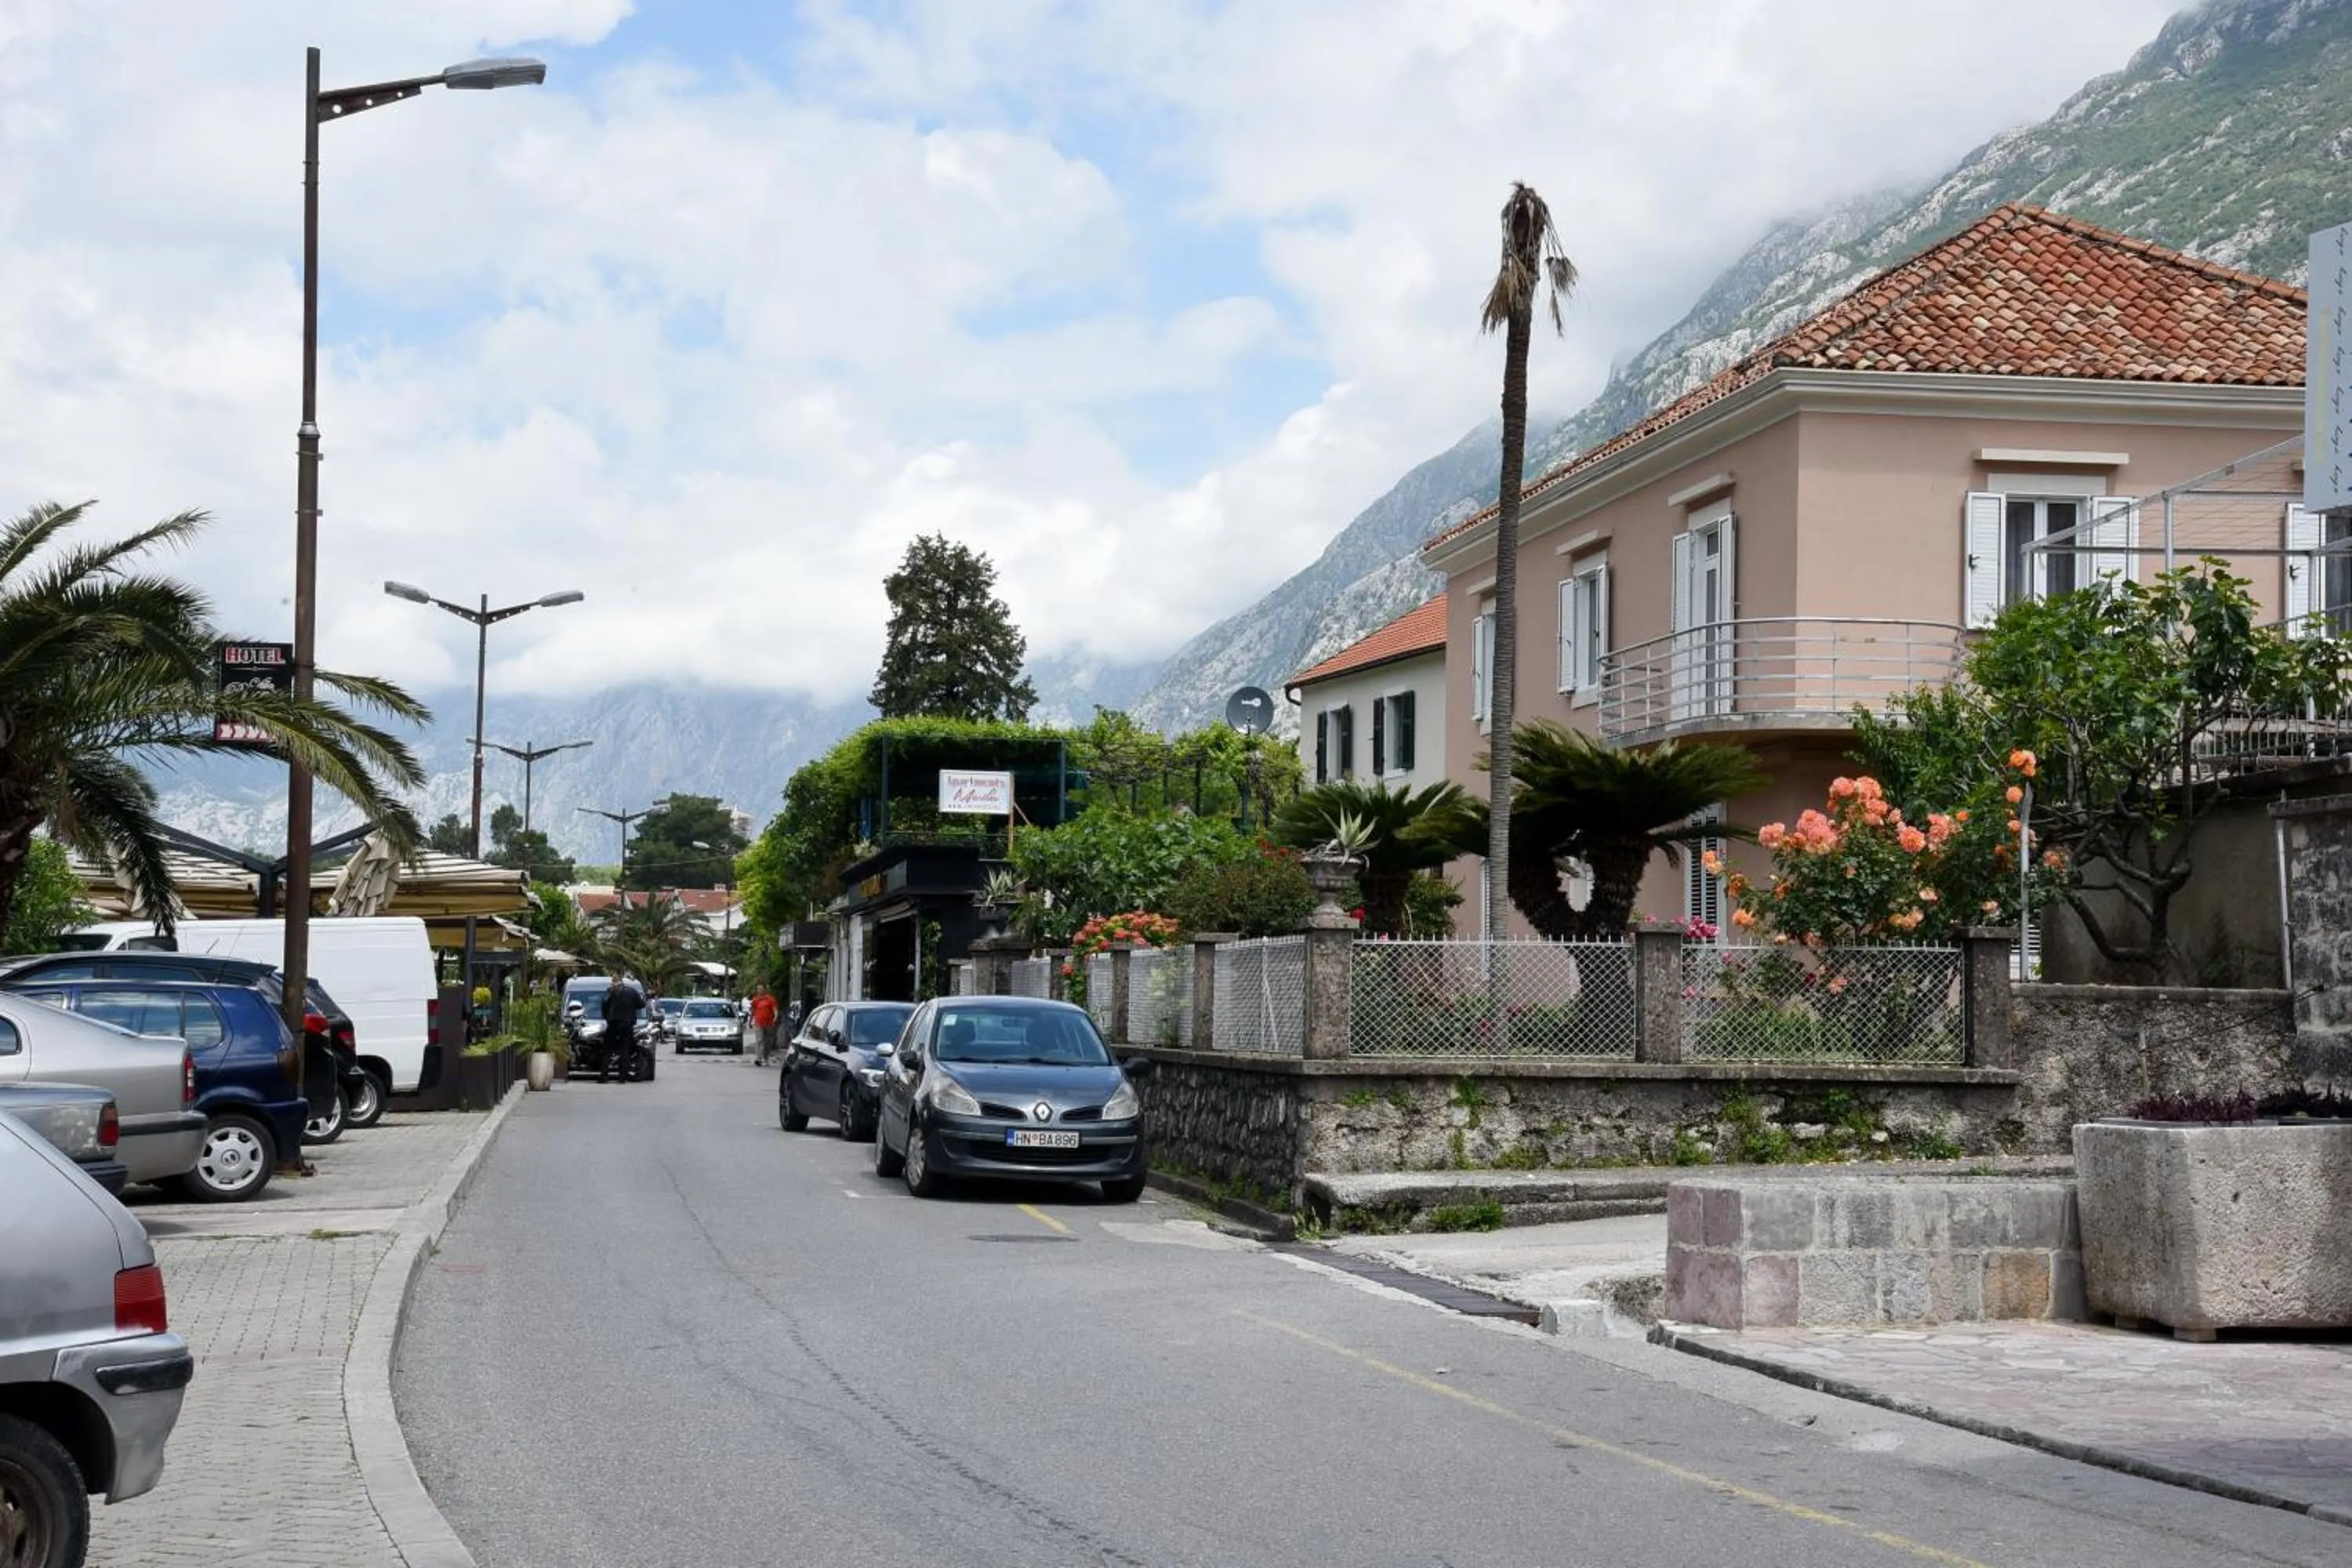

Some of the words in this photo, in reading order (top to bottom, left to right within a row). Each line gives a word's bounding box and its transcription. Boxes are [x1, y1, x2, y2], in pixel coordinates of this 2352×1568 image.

[225, 646, 286, 665] HOTEL
[1015, 1133, 1031, 1145] HN
[1039, 1133, 1076, 1146] BA896
